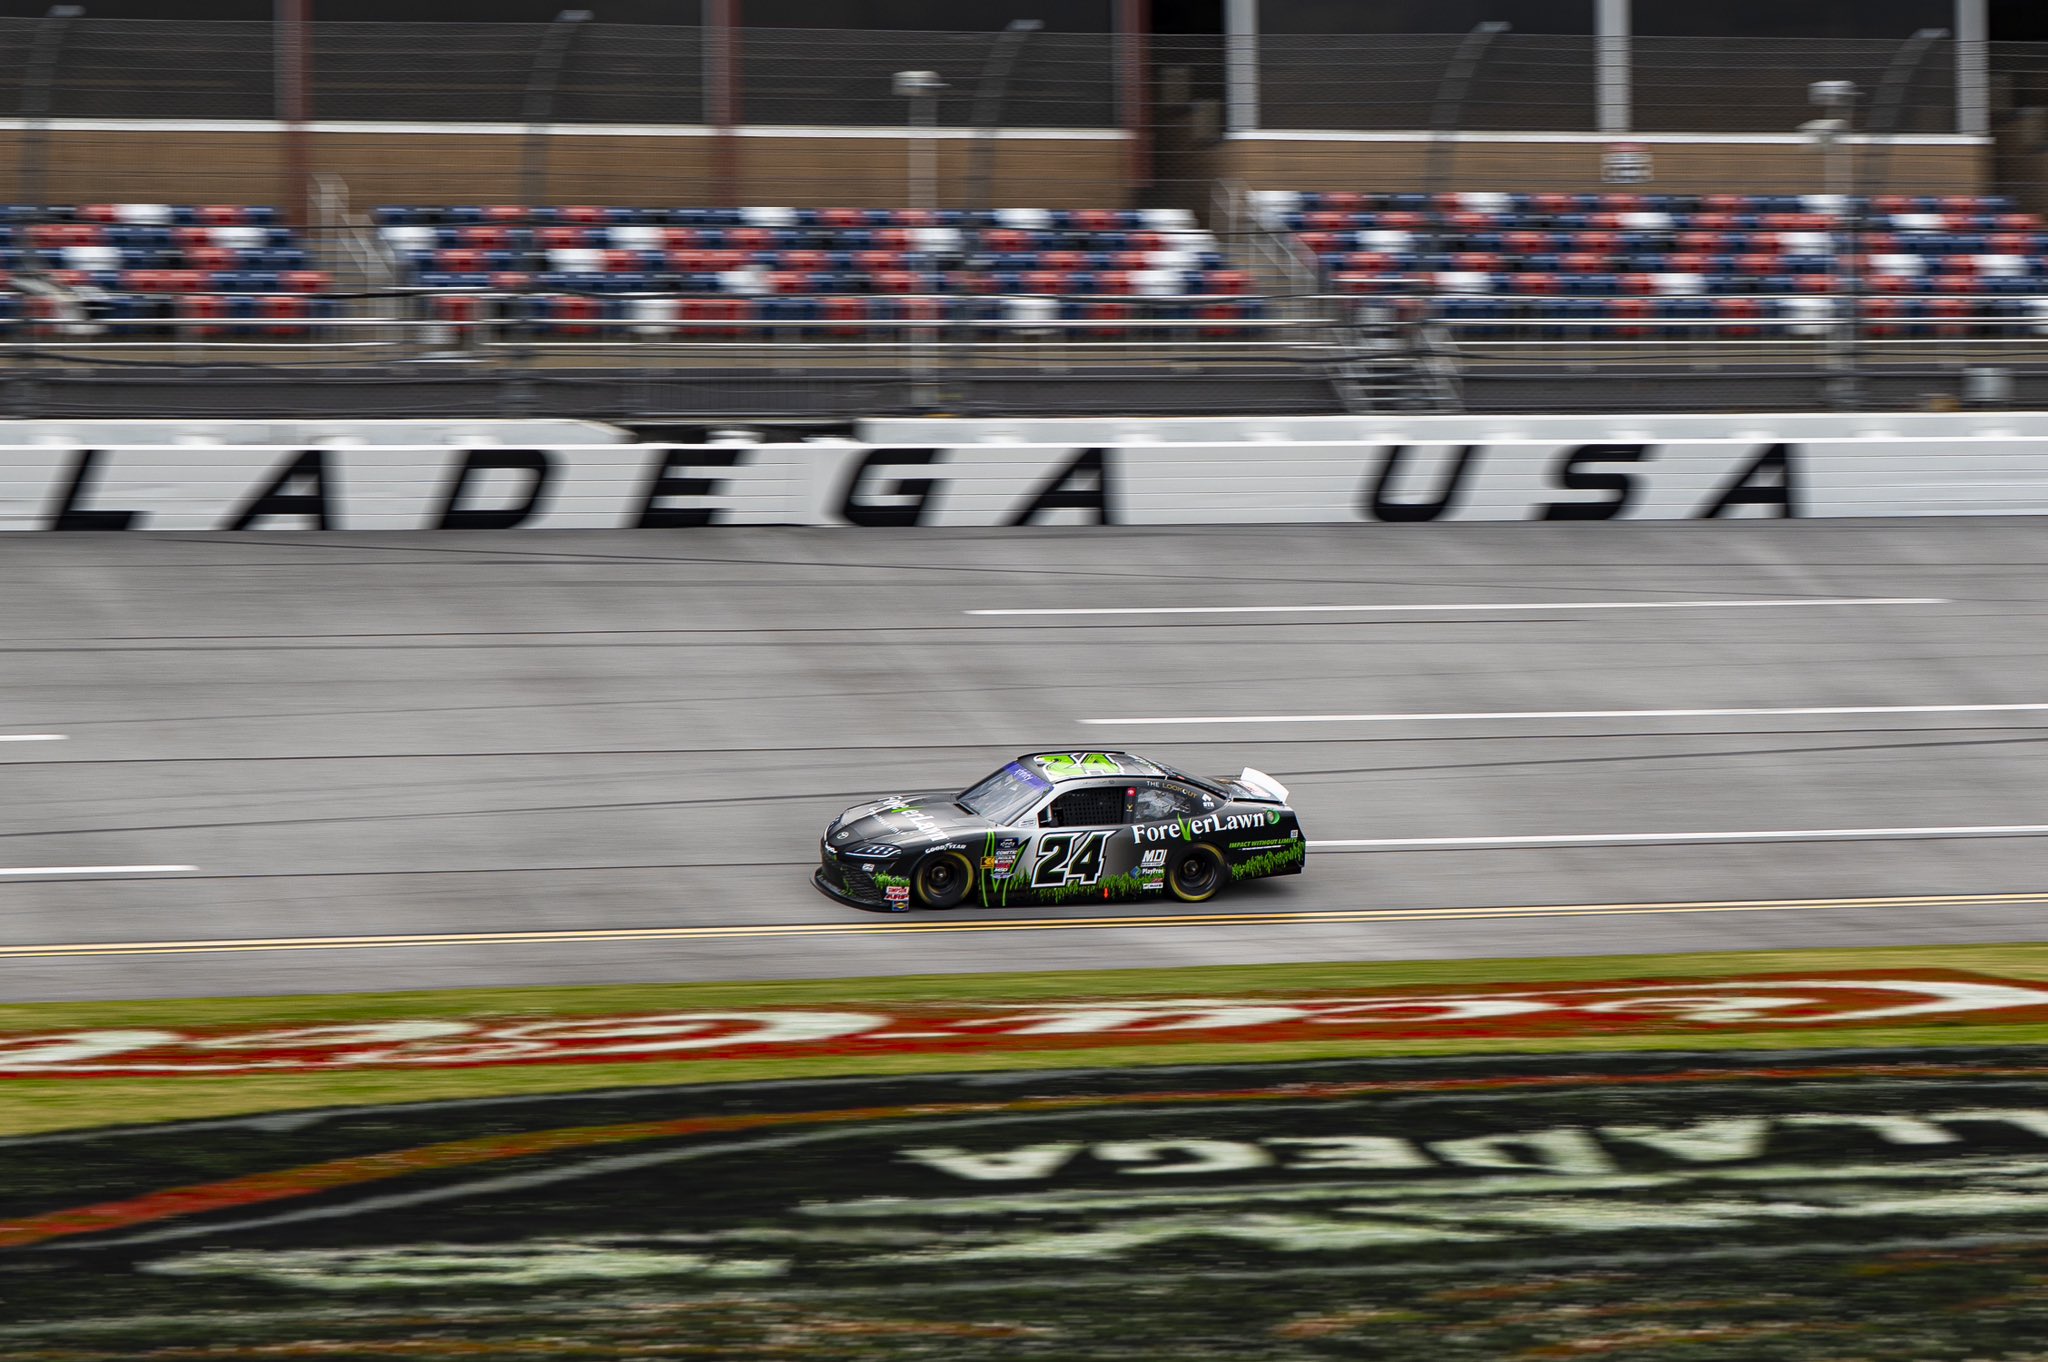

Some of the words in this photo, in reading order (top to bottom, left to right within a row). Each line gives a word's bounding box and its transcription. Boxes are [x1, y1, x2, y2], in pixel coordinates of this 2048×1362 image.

[48, 446, 1120, 531] LADEGA
[1354, 442, 1806, 522] USA
[1146, 780, 1160, 788] THE
[1162, 782, 1198, 799] LOOKOUT
[925, 842, 967, 854] GOODYEAR
[1228, 840, 1251, 849] IMPACT
[1251, 838, 1278, 847] WITHOUT
[1278, 837, 1298, 845] LIMITS
[1031, 829, 1118, 888] 24
